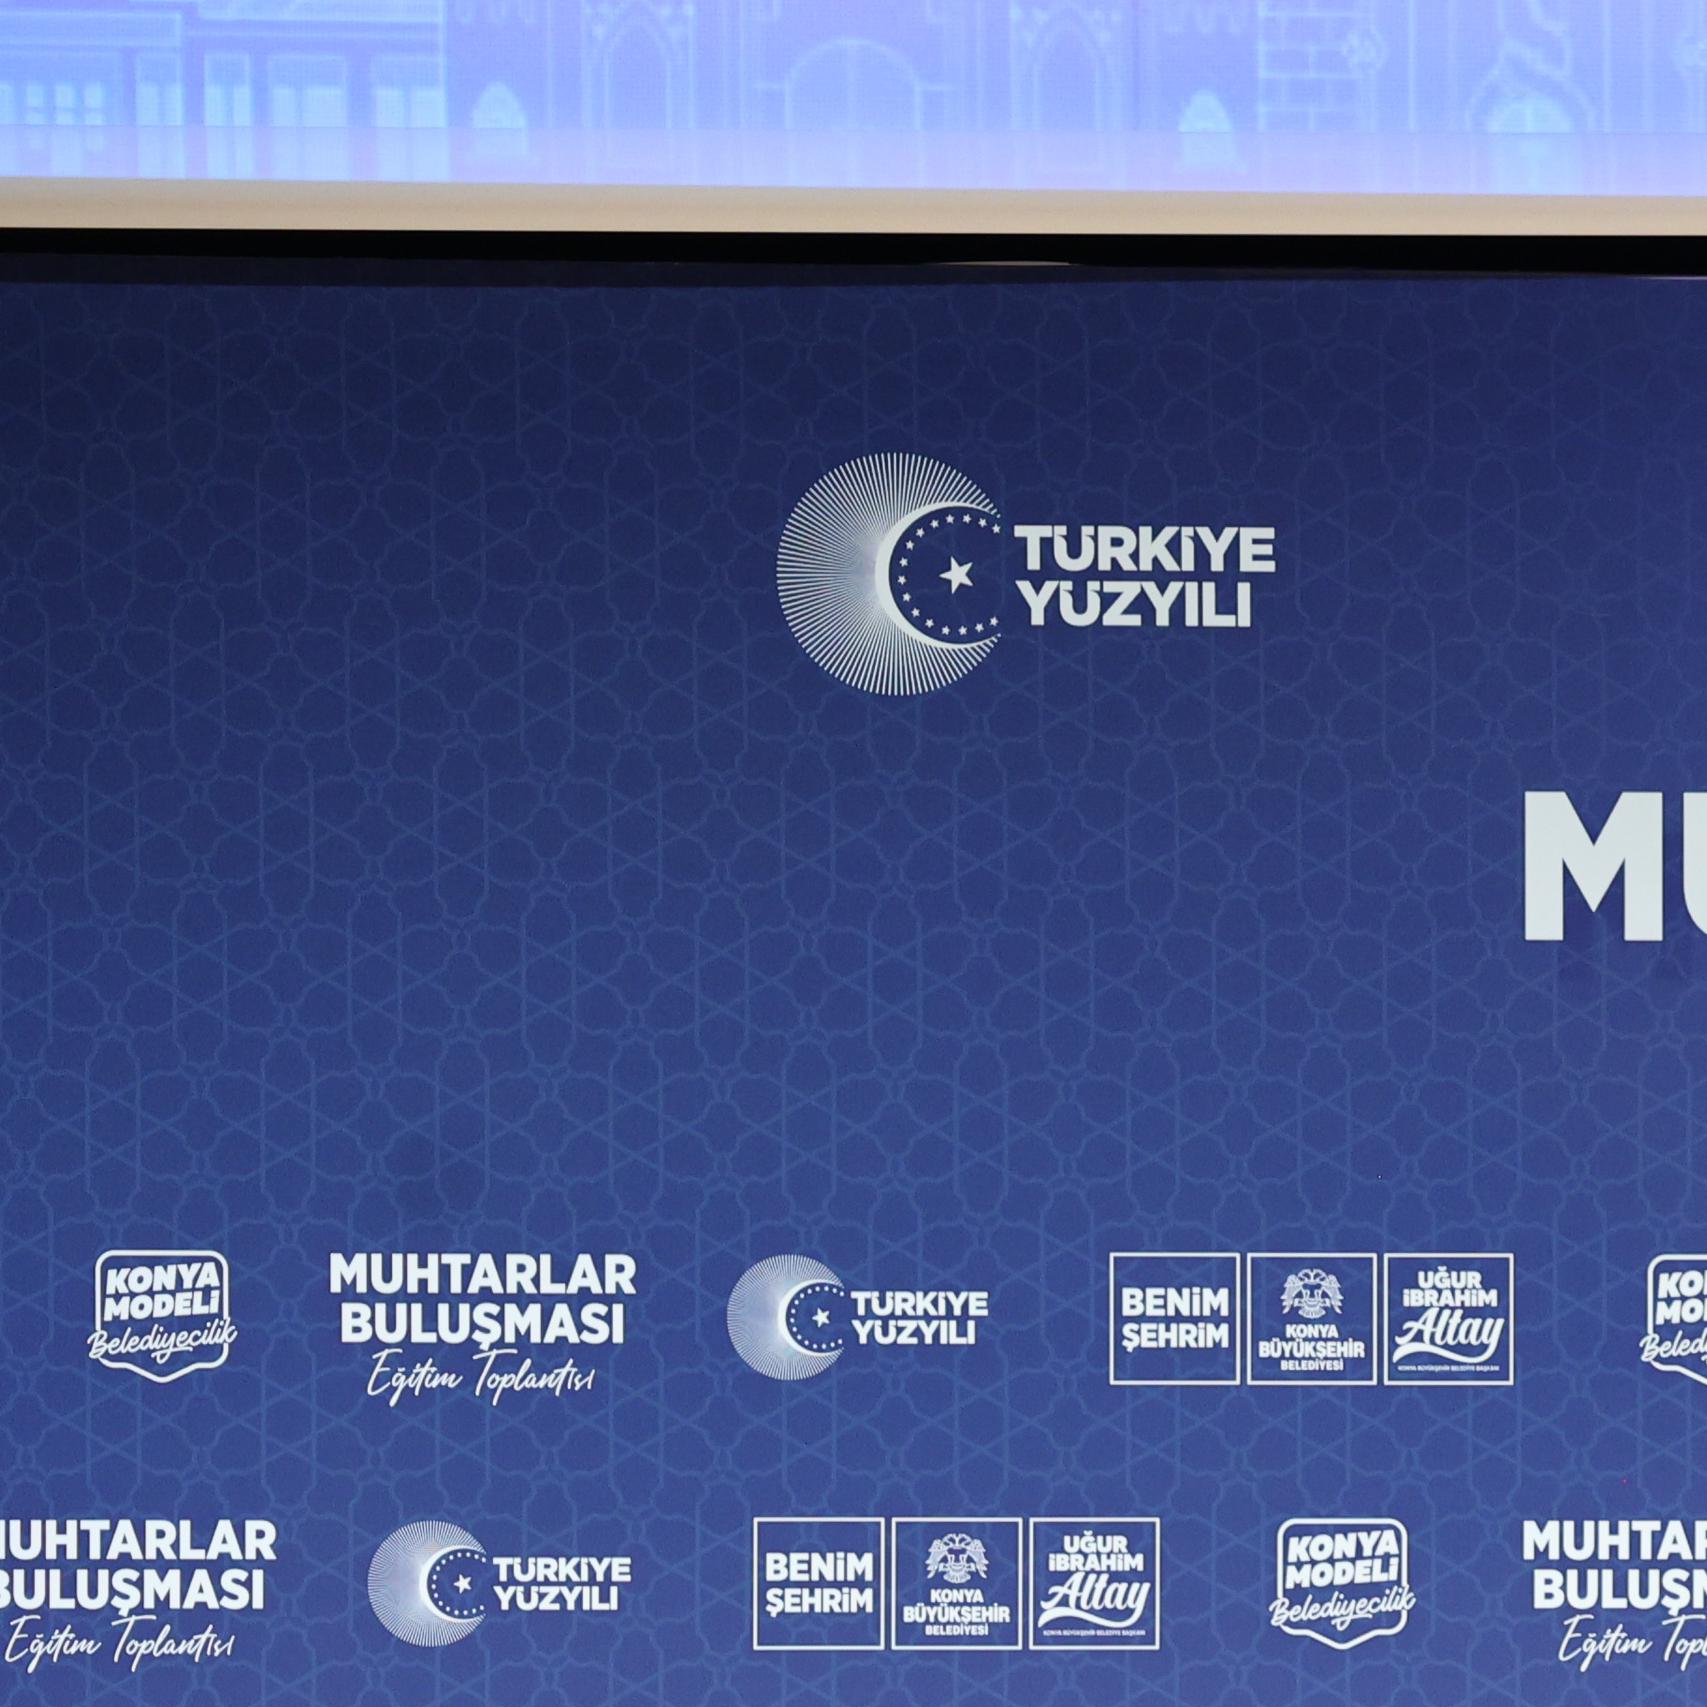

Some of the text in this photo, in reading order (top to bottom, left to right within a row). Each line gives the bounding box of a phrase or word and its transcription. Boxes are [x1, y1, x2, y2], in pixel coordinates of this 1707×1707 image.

[105, 1262, 221, 1295] KONYA
[330, 1253, 636, 1295] MUHTARLAR
[1417, 1266, 1482, 1289] UĞUR
[103, 1290, 221, 1322] MODELİ
[1122, 1287, 1229, 1317] BENİM
[87, 1317, 238, 1365] Belediyecilik
[341, 1303, 624, 1352] BULUŞMASI
[1122, 1322, 1229, 1353] ŞEHRİM
[1286, 1324, 1339, 1339] KONYA
[1392, 1307, 1505, 1364] Altay
[1258, 1338, 1366, 1361] BÜYÜKŞEHİR
[1280, 1358, 1344, 1371] BELEDİYESİ
[367, 1348, 596, 1408] Eğitim Toplantısı
[4, 1614, 236, 1674] Eğitim Toplantısı
[1560, 1614, 1653, 1674] Eğitim
